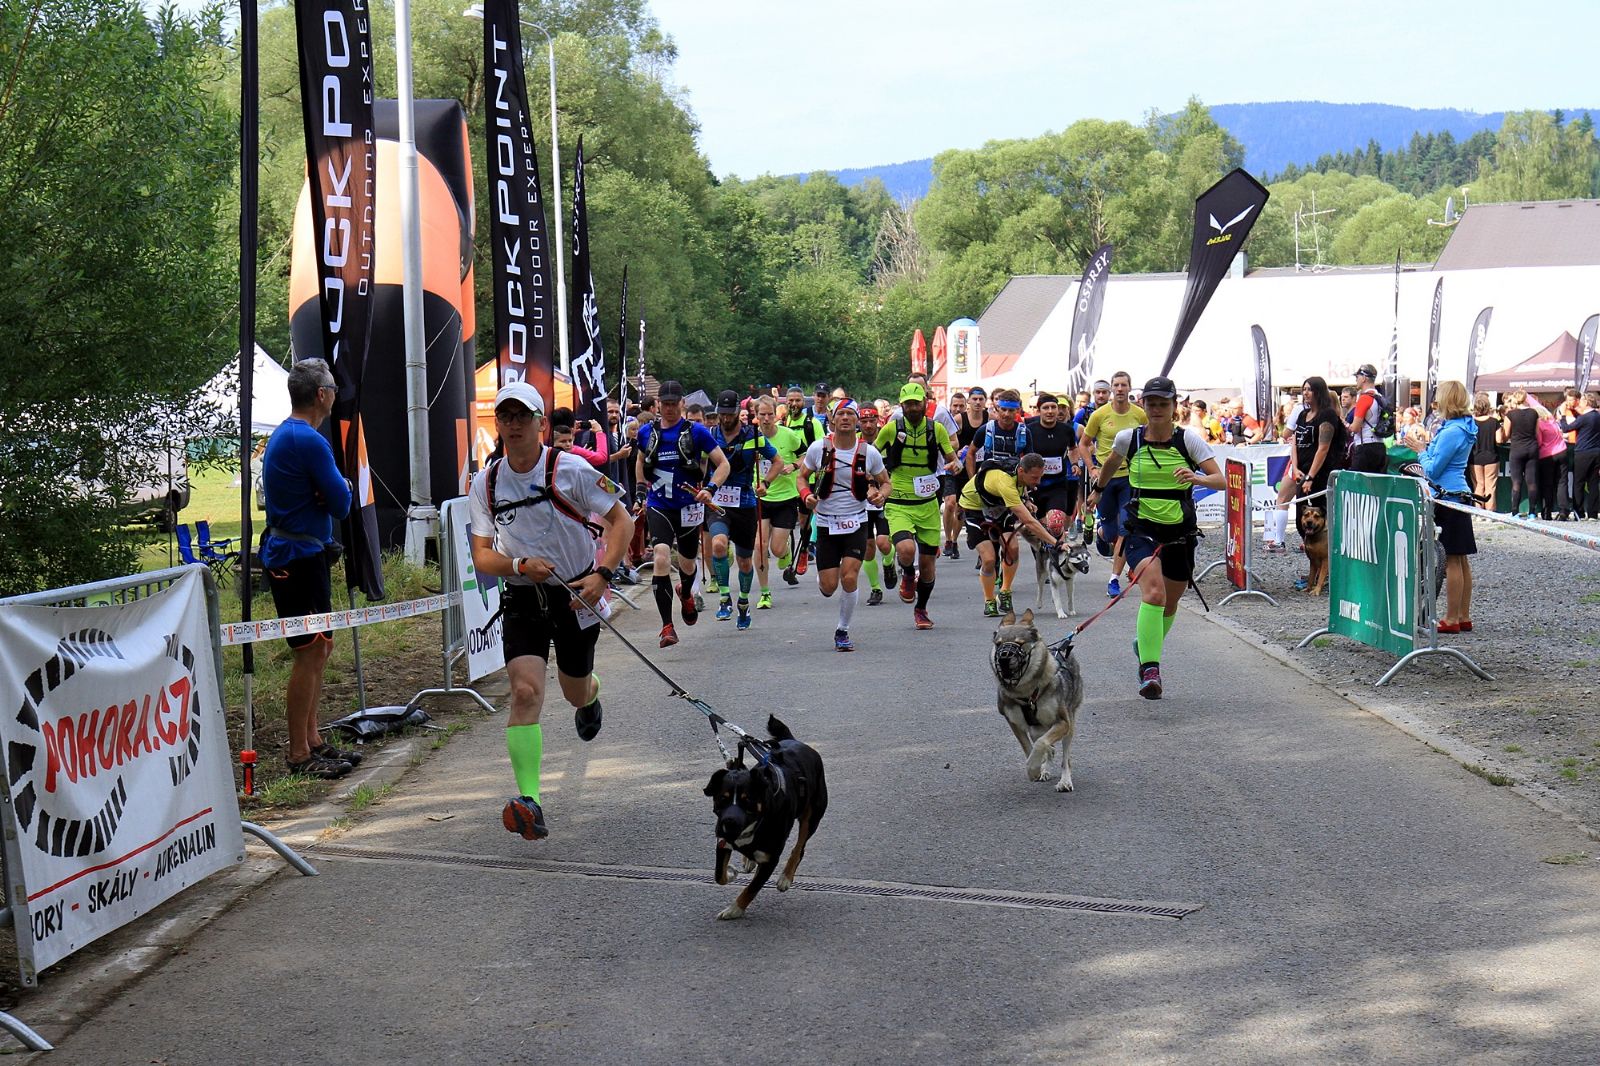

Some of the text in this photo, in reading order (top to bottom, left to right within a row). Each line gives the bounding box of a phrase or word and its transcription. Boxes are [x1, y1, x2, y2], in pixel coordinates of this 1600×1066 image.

[494, 24, 520, 225] POINT
[323, 155, 352, 364] OCK
[518, 110, 544, 338] OUTDOOR EXPERT
[717, 493, 735, 503] 281
[836, 520, 854, 531] 160
[920, 484, 936, 494] 285
[42, 676, 190, 793] POHORA.CZ
[88, 867, 138, 913] SKÁLY
[154, 823, 216, 882] ADRENALIN
